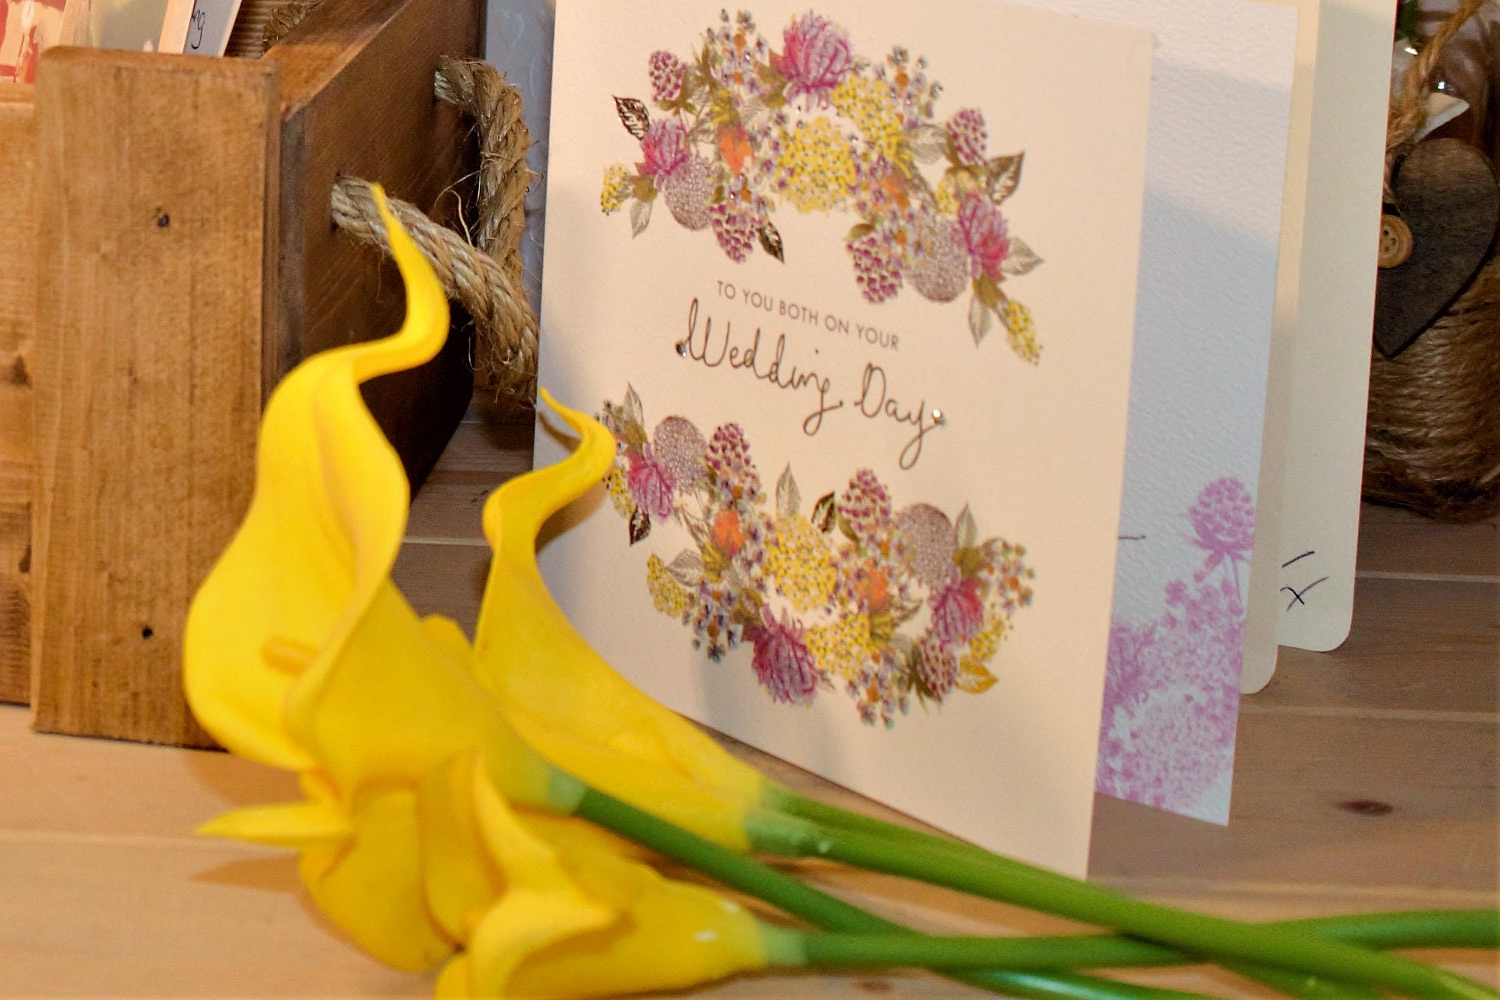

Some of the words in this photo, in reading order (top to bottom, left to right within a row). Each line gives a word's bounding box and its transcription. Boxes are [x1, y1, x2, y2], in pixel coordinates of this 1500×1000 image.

[716, 280, 737, 300] TO
[742, 288, 774, 312] YOU
[779, 300, 819, 327] BOTH
[824, 314, 850, 336] ON
[855, 324, 900, 351] YOUR
[677, 297, 844, 436] Wedding
[853, 361, 943, 471] Day
